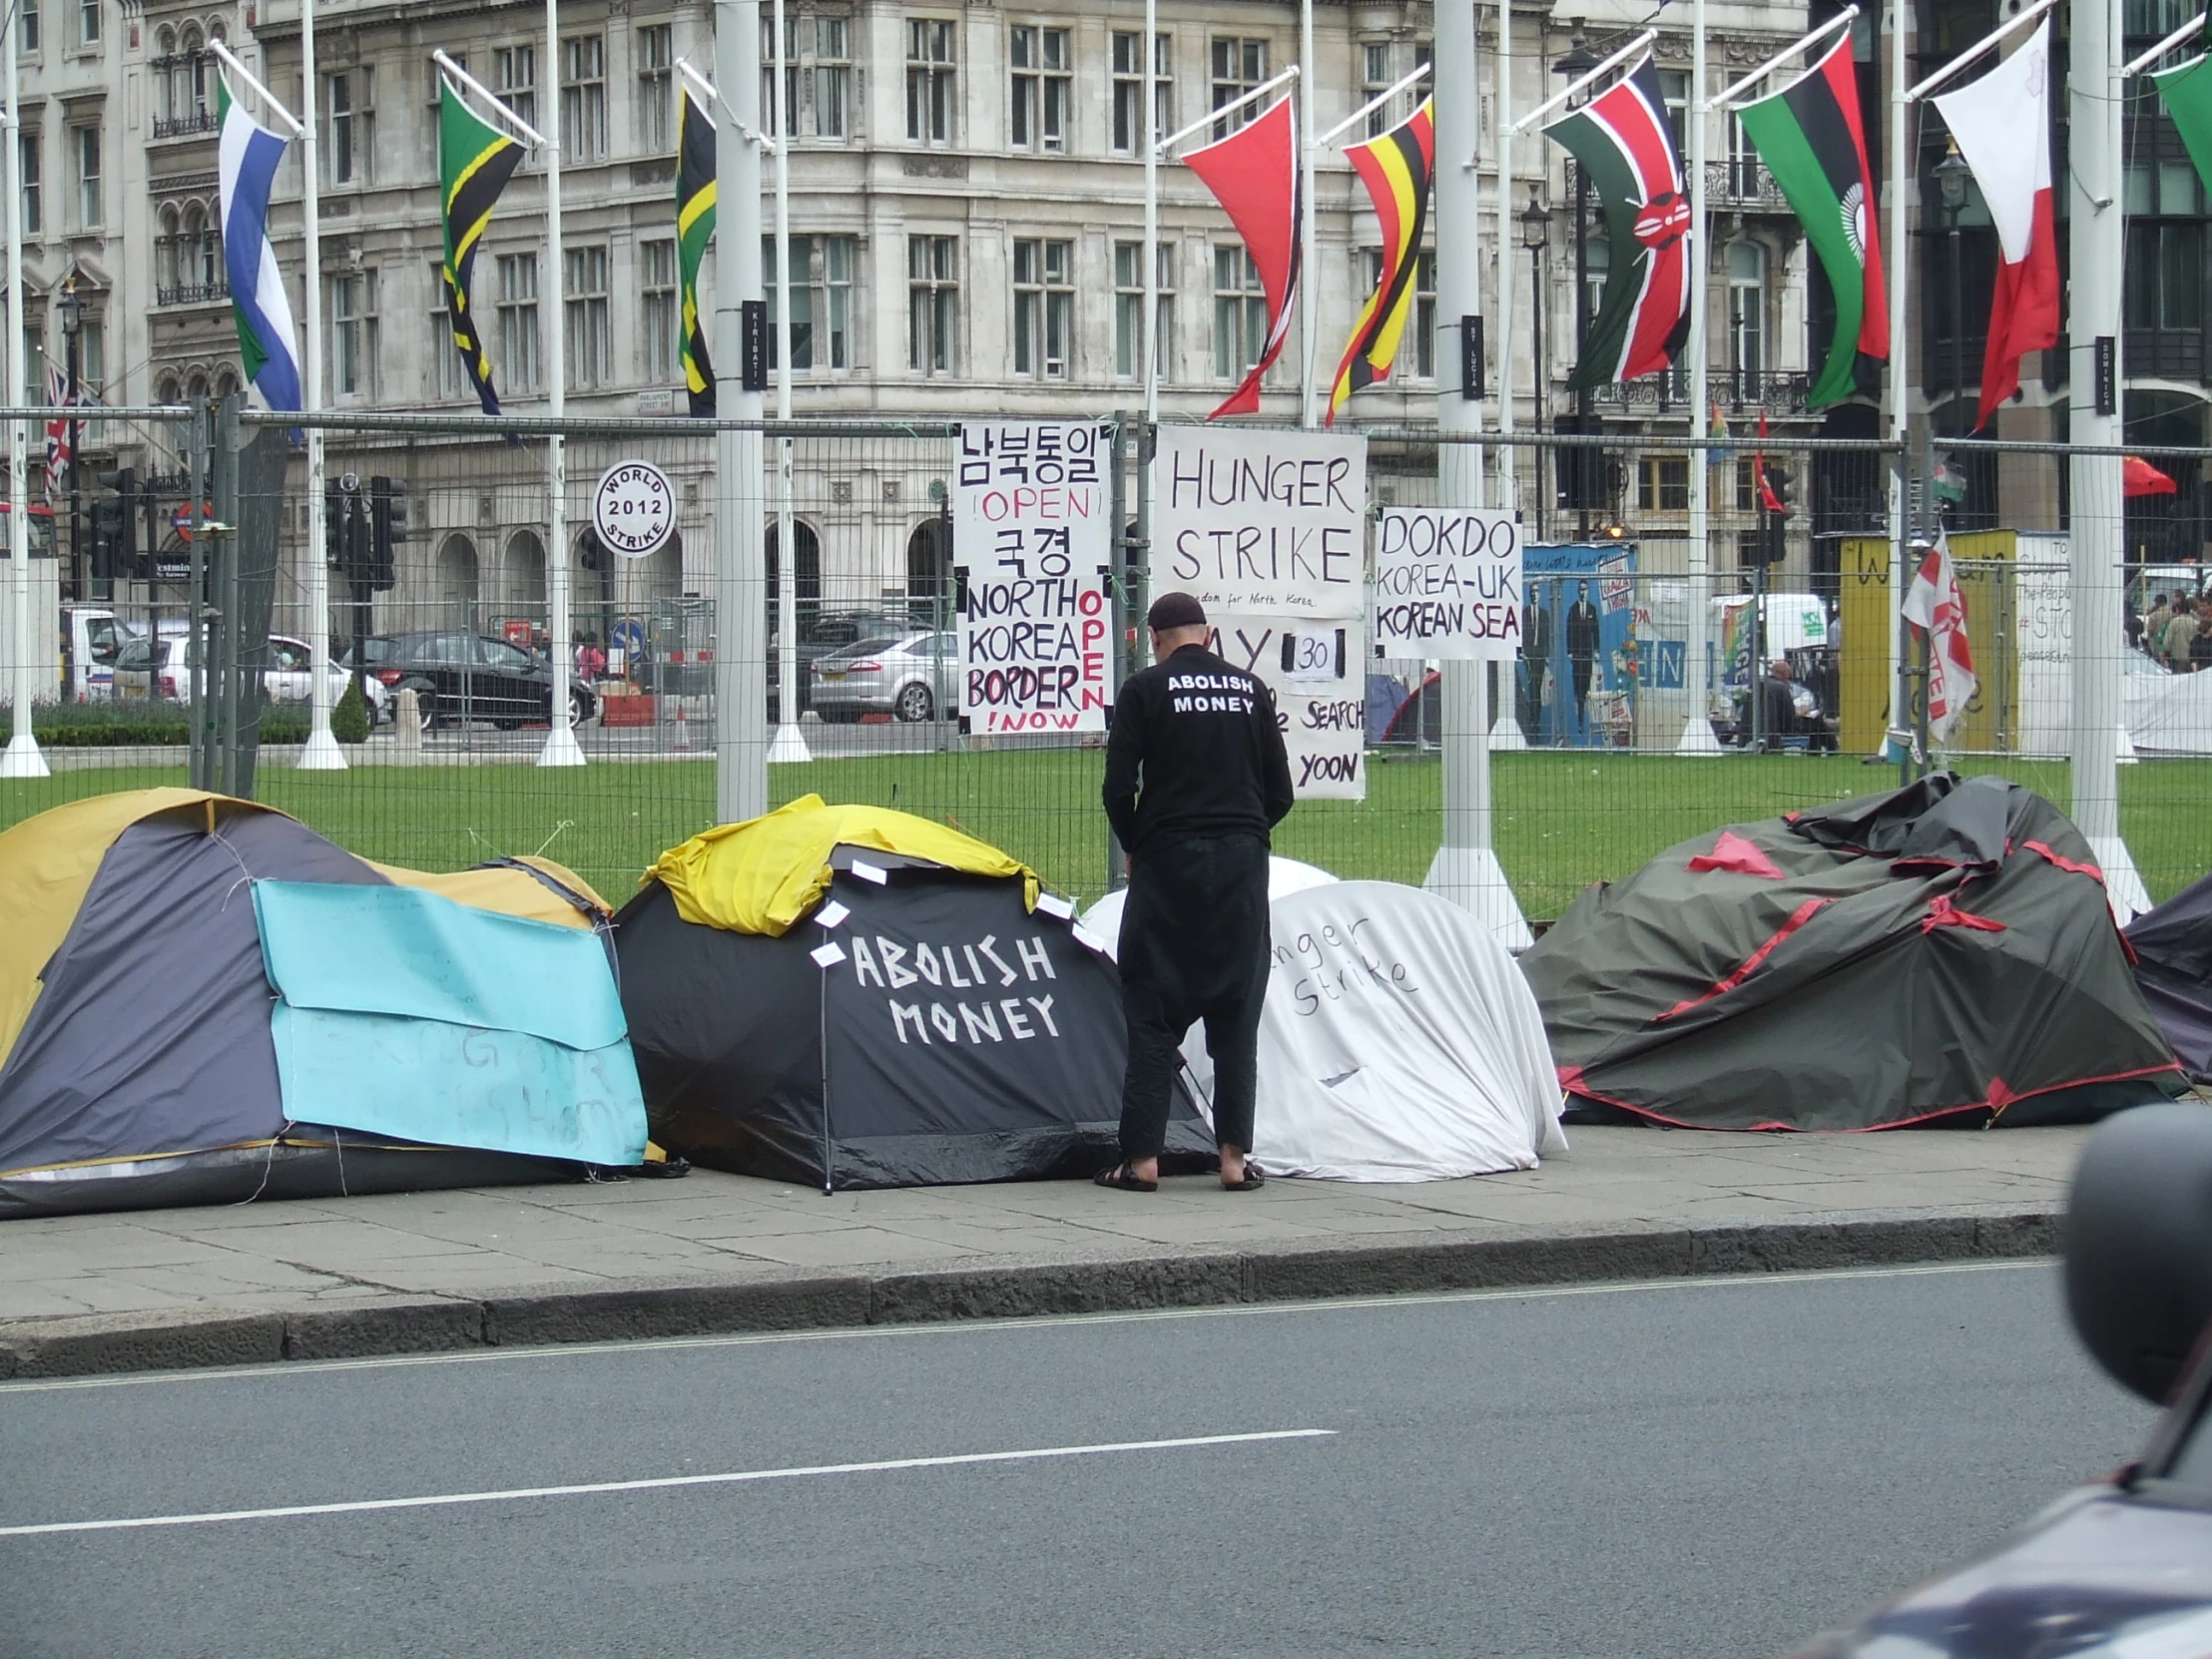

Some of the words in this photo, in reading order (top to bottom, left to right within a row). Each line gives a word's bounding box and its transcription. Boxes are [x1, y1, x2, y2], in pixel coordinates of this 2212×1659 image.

[1470, 326, 1476, 342] ST
[960, 426, 1099, 487] 남북통일
[606, 469, 662, 494] WORLD
[1172, 448, 1355, 514] HUNGER
[608, 500, 662, 515] 2012
[607, 522, 663, 548] STRIKE
[1382, 515, 1515, 559] DOKDO
[1172, 526, 1352, 584] STRIKE
[967, 578, 1077, 623] NORTH
[1228, 593, 1242, 609] for
[1249, 592, 1278, 605] North
[1378, 563, 1519, 603] KOREA-UK
[1377, 602, 1464, 640] KOREAN
[1468, 603, 1519, 640] SEA
[968, 622, 1080, 664] KOREA
[1298, 637, 1328, 670] 30
[966, 665, 1081, 712] BORDER
[1168, 675, 1254, 694] ABOLISH
[1174, 697, 1254, 714] MONEY
[1300, 700, 1365, 731] SEARCH
[1298, 752, 1359, 788] YOON
[851, 933, 1056, 989] ABOLISH
[1295, 955, 1418, 1016] Strike
[889, 993, 1059, 1044] MONEY
